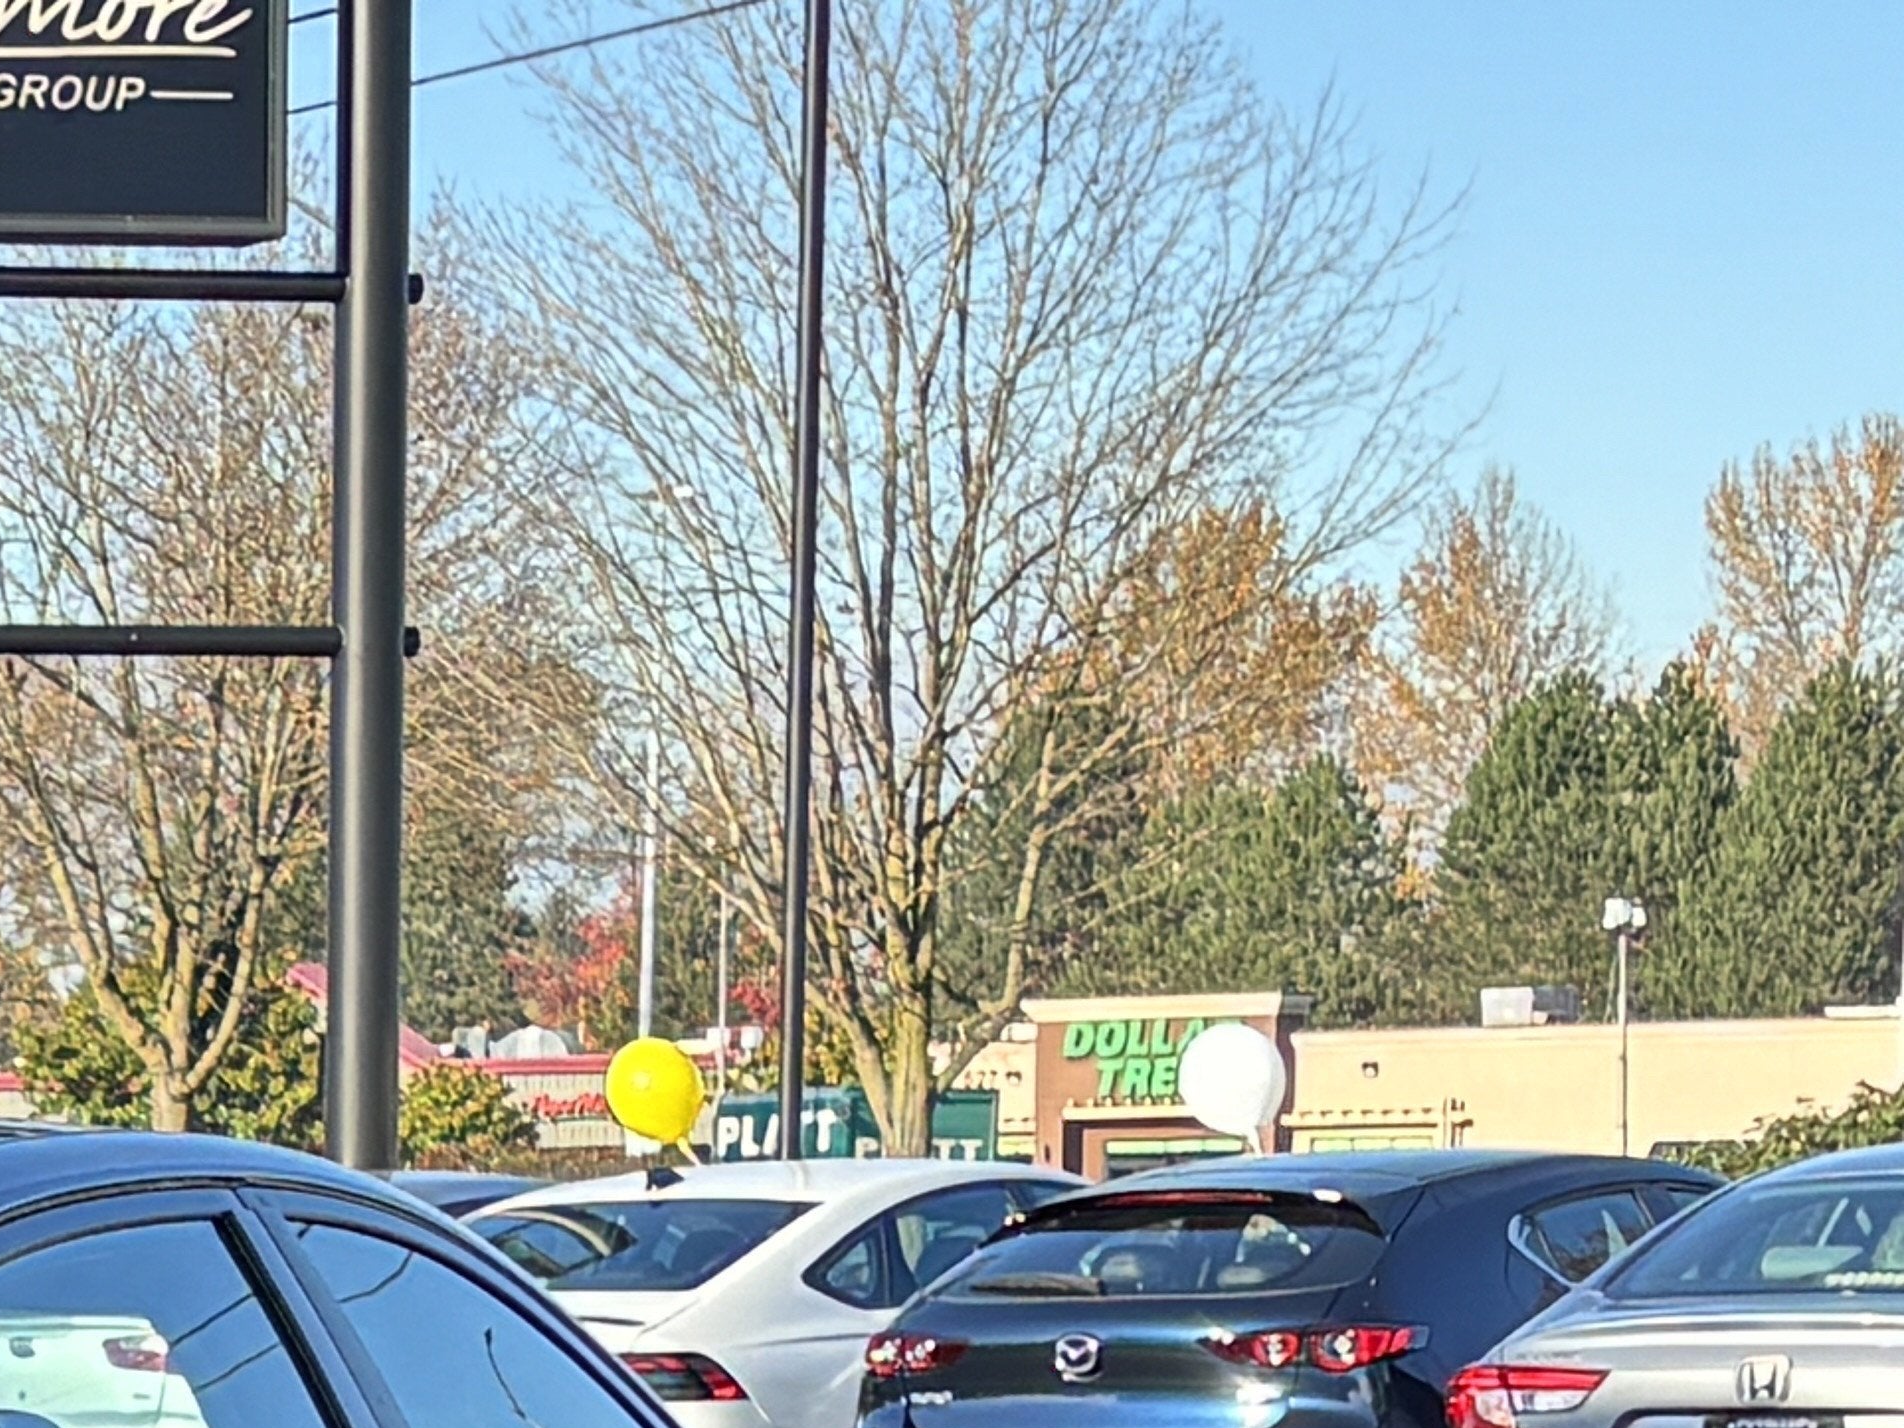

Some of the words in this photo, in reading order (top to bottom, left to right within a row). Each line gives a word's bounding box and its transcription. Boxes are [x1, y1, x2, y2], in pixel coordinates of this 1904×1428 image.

[1062, 1018, 1210, 1059] DOLL
[1095, 1056, 1180, 1099] TRE
[717, 1109, 837, 1157] PLT
[855, 1137, 983, 1160] PTT
